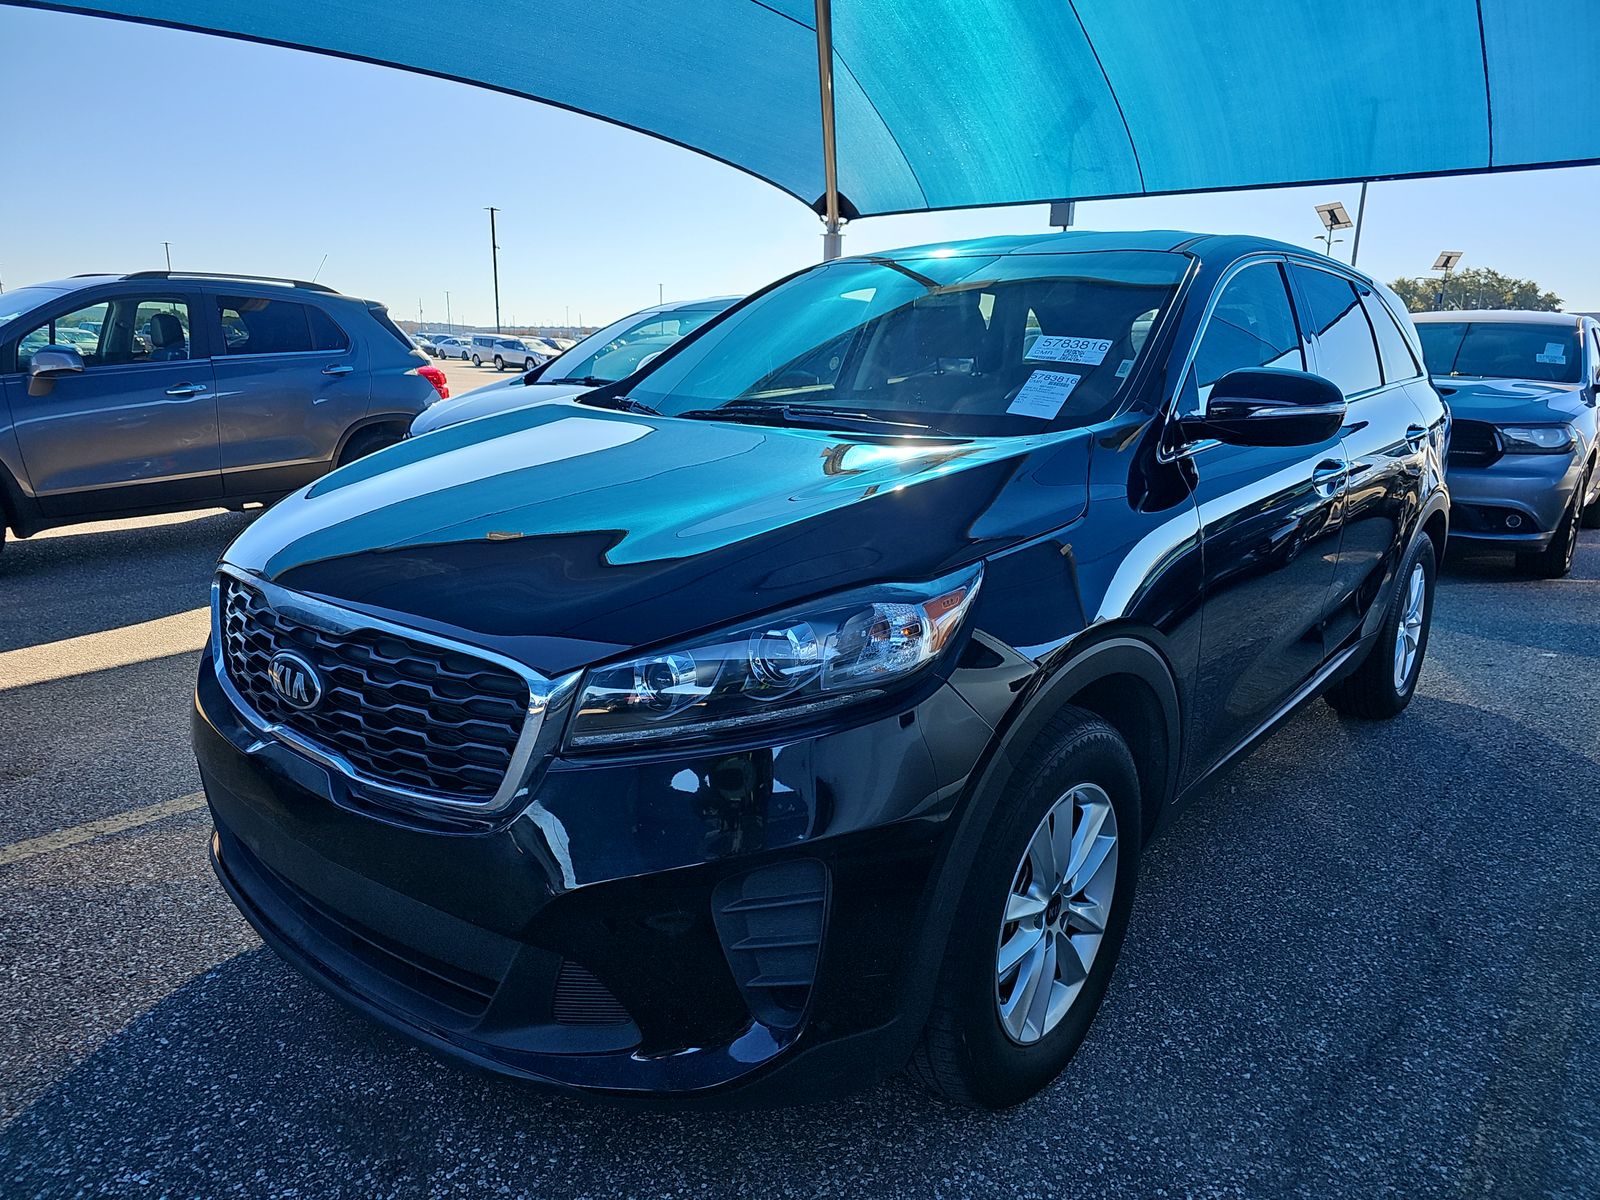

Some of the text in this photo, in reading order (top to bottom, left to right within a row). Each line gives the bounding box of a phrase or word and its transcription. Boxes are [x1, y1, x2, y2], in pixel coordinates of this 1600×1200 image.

[1042, 338, 1109, 352] 5783816
[1030, 372, 1078, 385] 5783816
[271, 661, 309, 703] KIA
